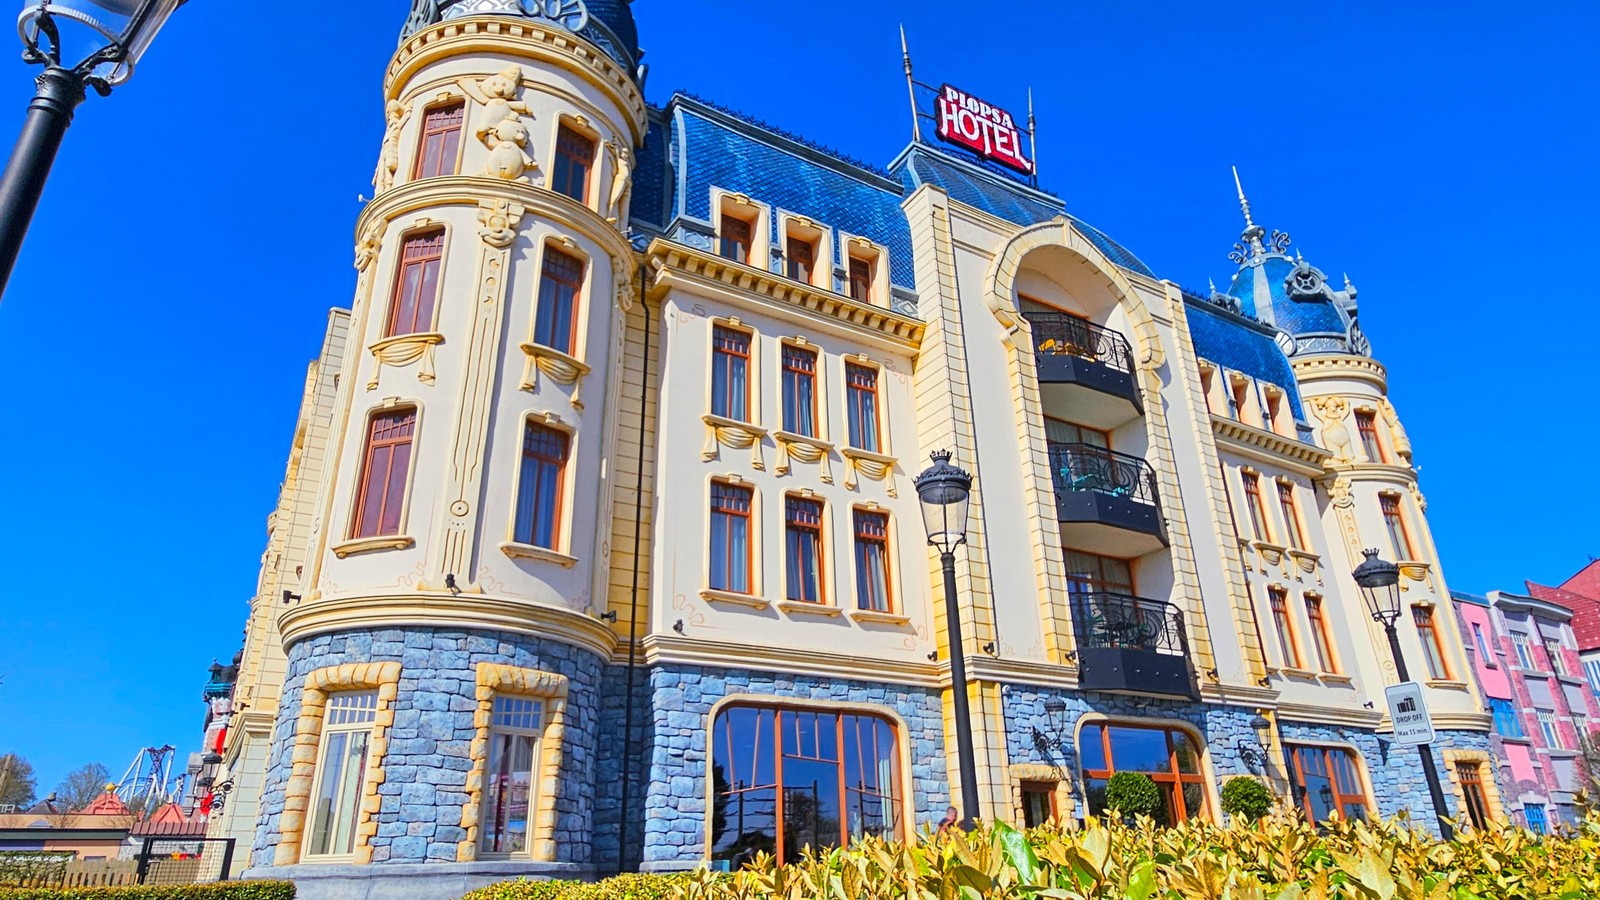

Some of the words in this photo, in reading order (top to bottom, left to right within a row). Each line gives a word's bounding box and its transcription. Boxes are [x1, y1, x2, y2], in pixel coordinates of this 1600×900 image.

[945, 86, 1014, 130] PLOPSA
[940, 98, 1031, 170] HOTEL
[1396, 715, 1411, 724] DROP
